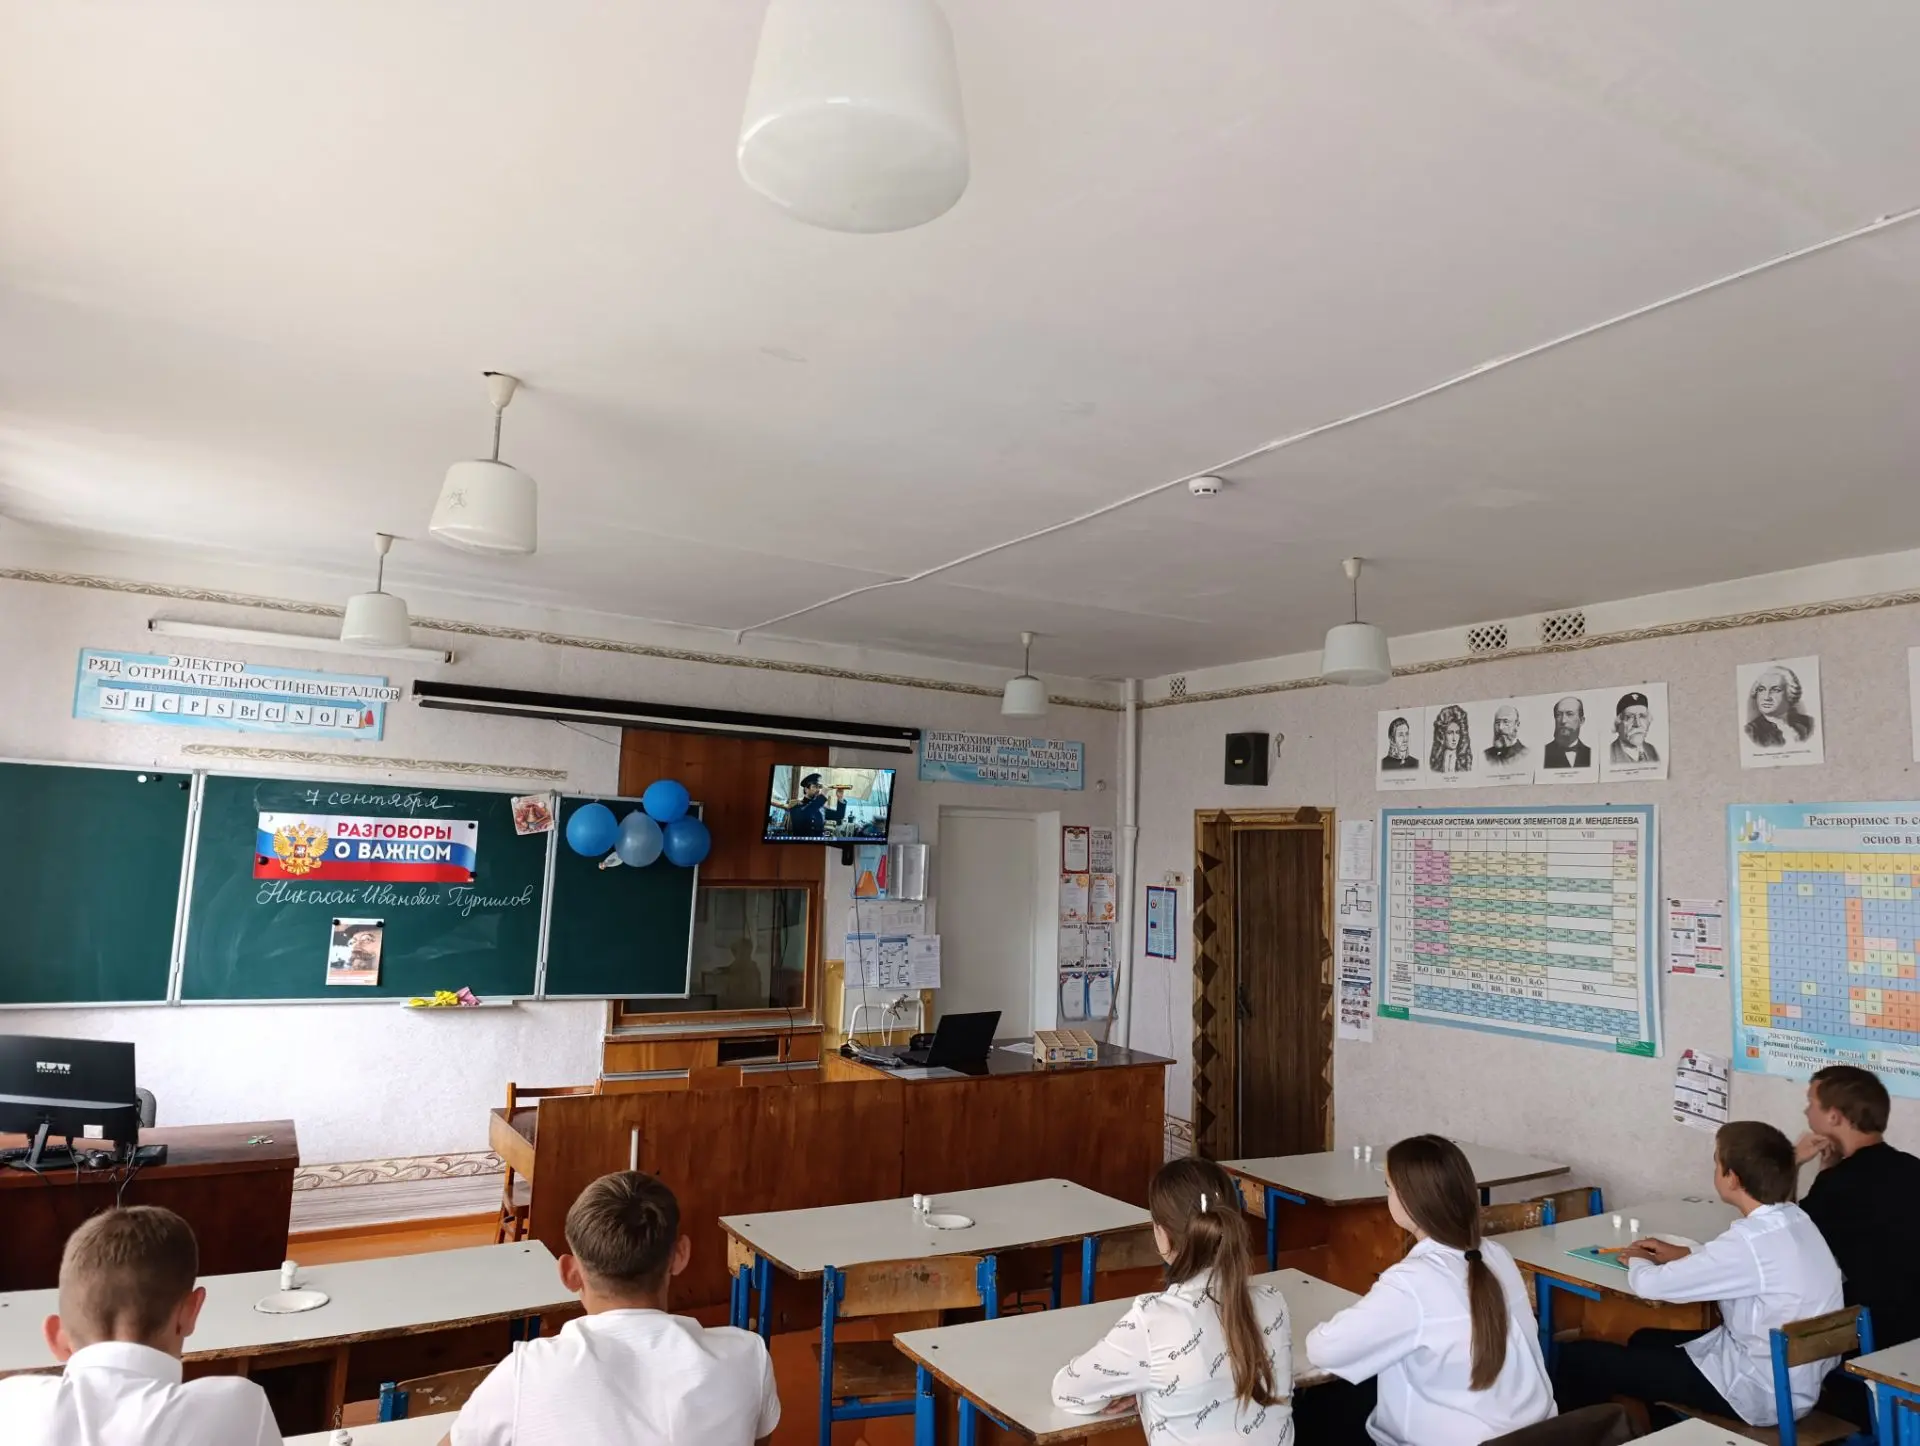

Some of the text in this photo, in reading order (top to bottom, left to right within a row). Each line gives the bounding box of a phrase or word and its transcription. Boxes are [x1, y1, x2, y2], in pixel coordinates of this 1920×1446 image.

[88, 658, 121, 673] РЯД
[169, 656, 244, 673] ЭЛЕКТРО
[128, 665, 292, 691] ОТРИЦАТЕЛЬНОСТИ
[295, 681, 399, 700] НЕМЕТАЛЛОВ
[105, 694, 355, 724] Si H C P S Br Cl N O F
[929, 732, 1032, 748] ЭЛЕКТРОХИМИЧЕСКИЙ
[929, 743, 991, 754] НАПРЯЖЕНИЯ
[305, 790, 454, 815] 7 сентября
[1391, 818, 1443, 826] ПЕРИОДИЧЕСКАЯ
[1444, 818, 1475, 826] СИСТЕМА
[1476, 818, 1521, 826] ХИМИЧЕСКИХ
[1523, 817, 1567, 826] ЭЛЕМЕНТОВ
[1585, 816, 1639, 825] МЕНДЕЛЕЕВА
[337, 822, 452, 840] РАЗГОВОРЫ
[1862, 836, 1900, 845] основ
[334, 843, 452, 861] О ВАЖНОМ
[256, 881, 357, 905] Николай
[361, 884, 440, 906] Иванович
